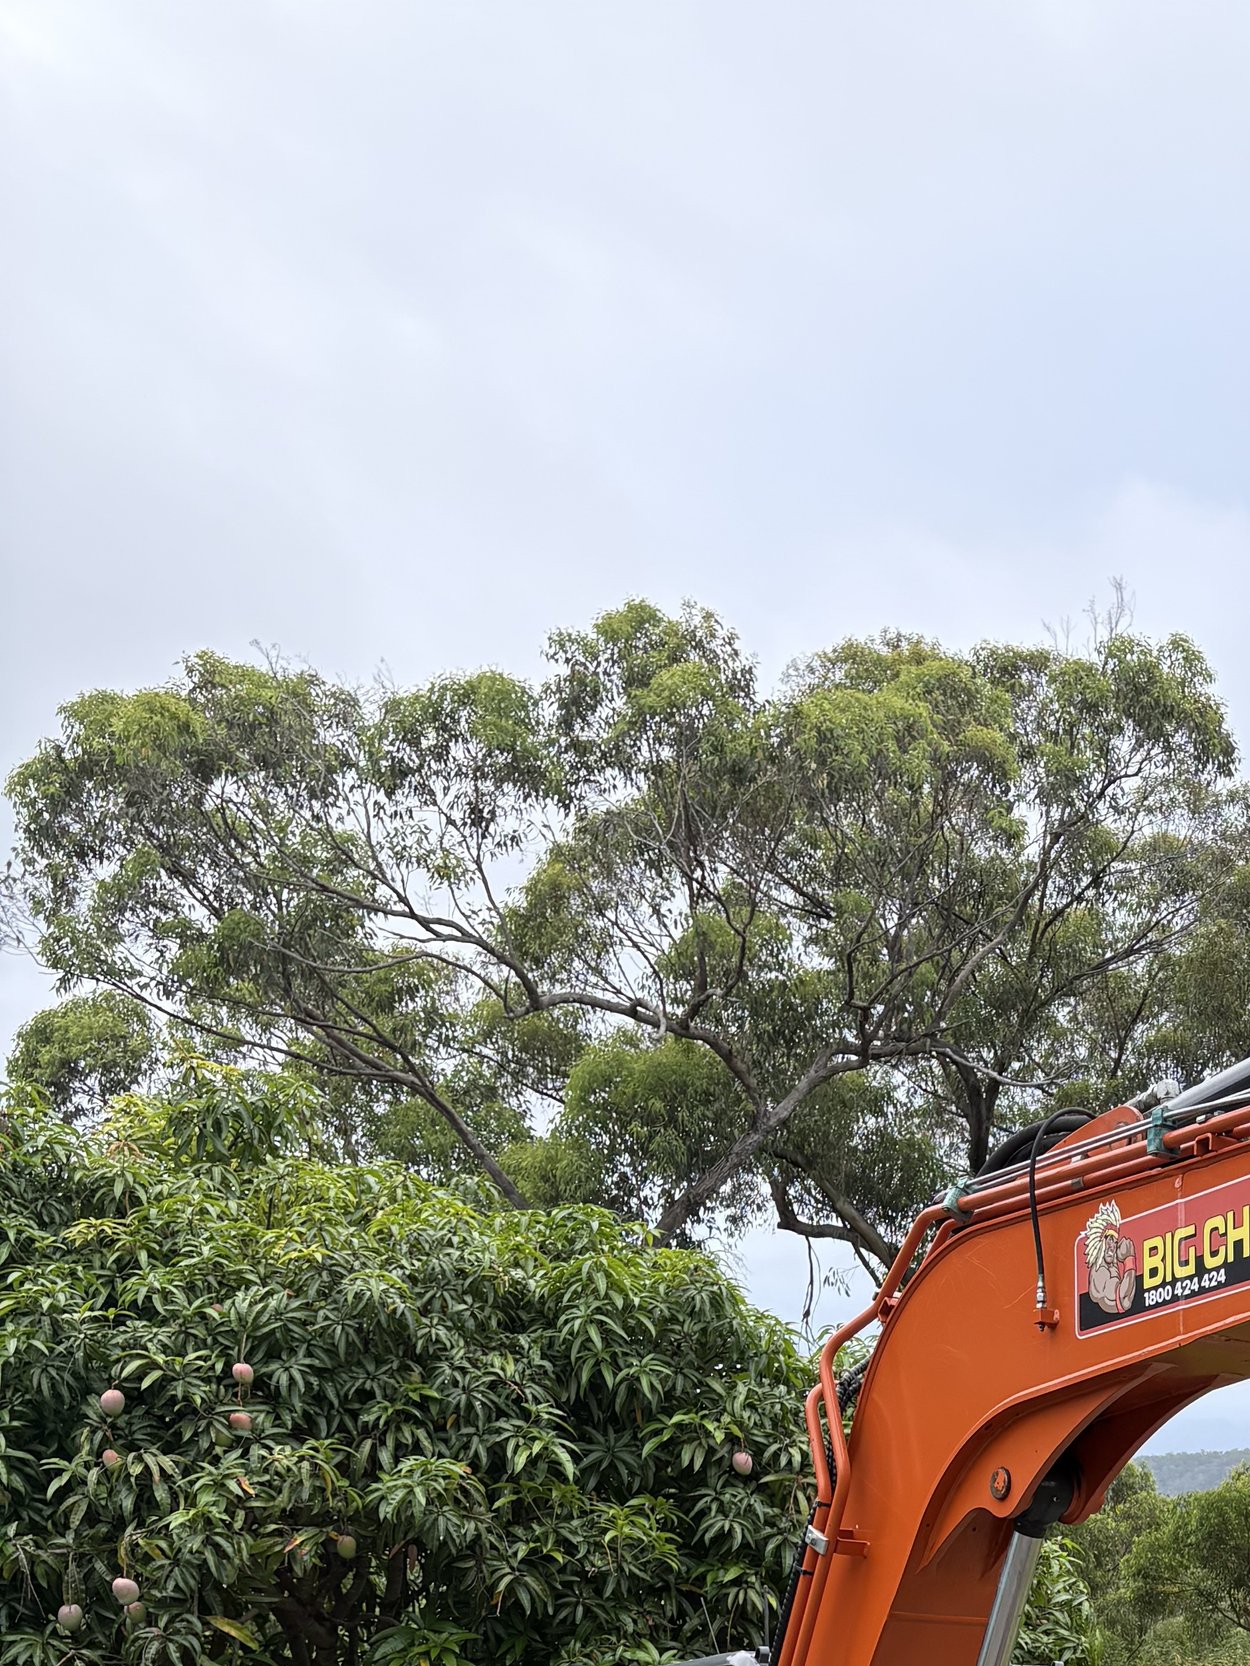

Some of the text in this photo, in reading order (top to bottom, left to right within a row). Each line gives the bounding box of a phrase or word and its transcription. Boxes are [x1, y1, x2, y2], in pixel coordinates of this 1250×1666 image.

[1143, 1224, 1197, 1290] BIG
[1144, 1268, 1226, 1307] 1800 424 424
